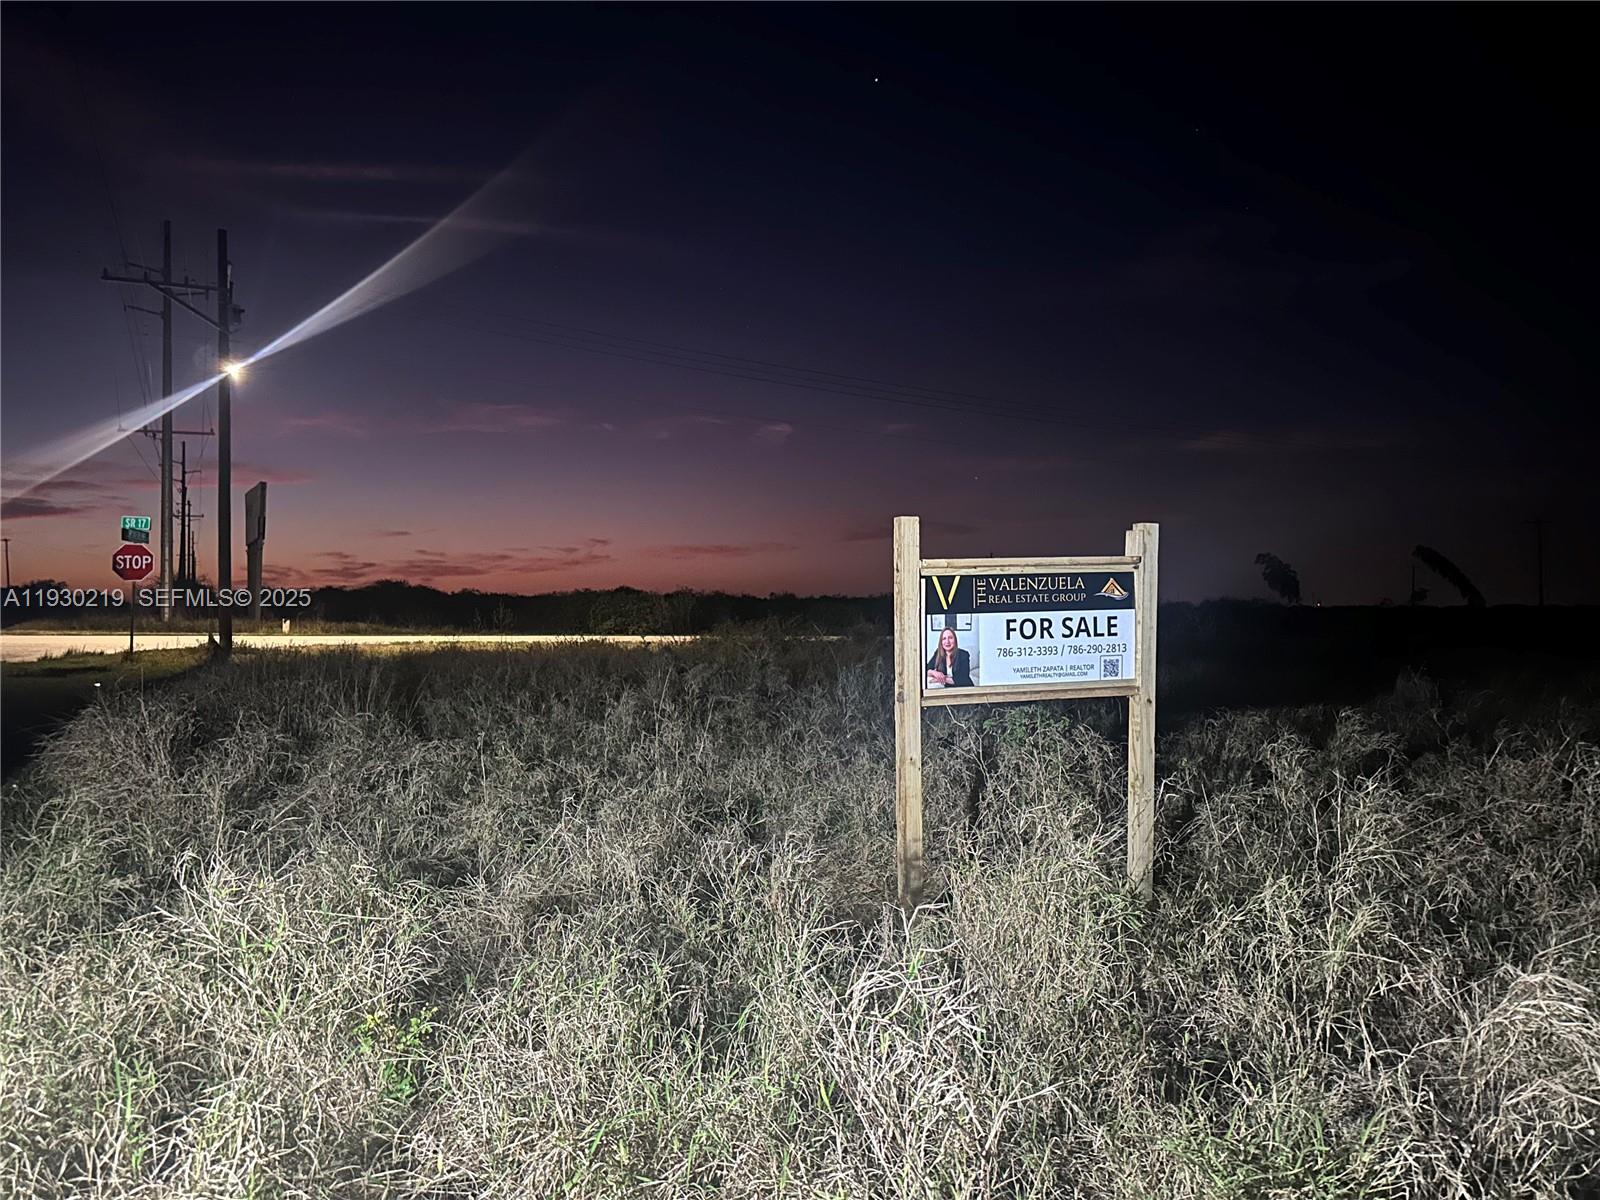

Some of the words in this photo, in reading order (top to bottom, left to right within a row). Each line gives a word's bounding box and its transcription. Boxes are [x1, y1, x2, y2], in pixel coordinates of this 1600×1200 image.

[125, 518, 135, 528] SR
[116, 555, 151, 569] STOP
[988, 577, 1085, 591] VALENZUELA
[976, 578, 987, 606] THE
[988, 594, 1013, 604] REAL
[1015, 594, 1050, 603] ESTATE
[1052, 593, 1086, 602] GROUP
[1005, 618, 1055, 641] FOR
[1061, 615, 1118, 639] SALE
[996, 646, 1059, 658] 786-312-3393
[1067, 643, 1127, 655] 786-290-2813
[1012, 666, 1042, 674] YAMILETH
[1042, 665, 1064, 673] ZAPATA
